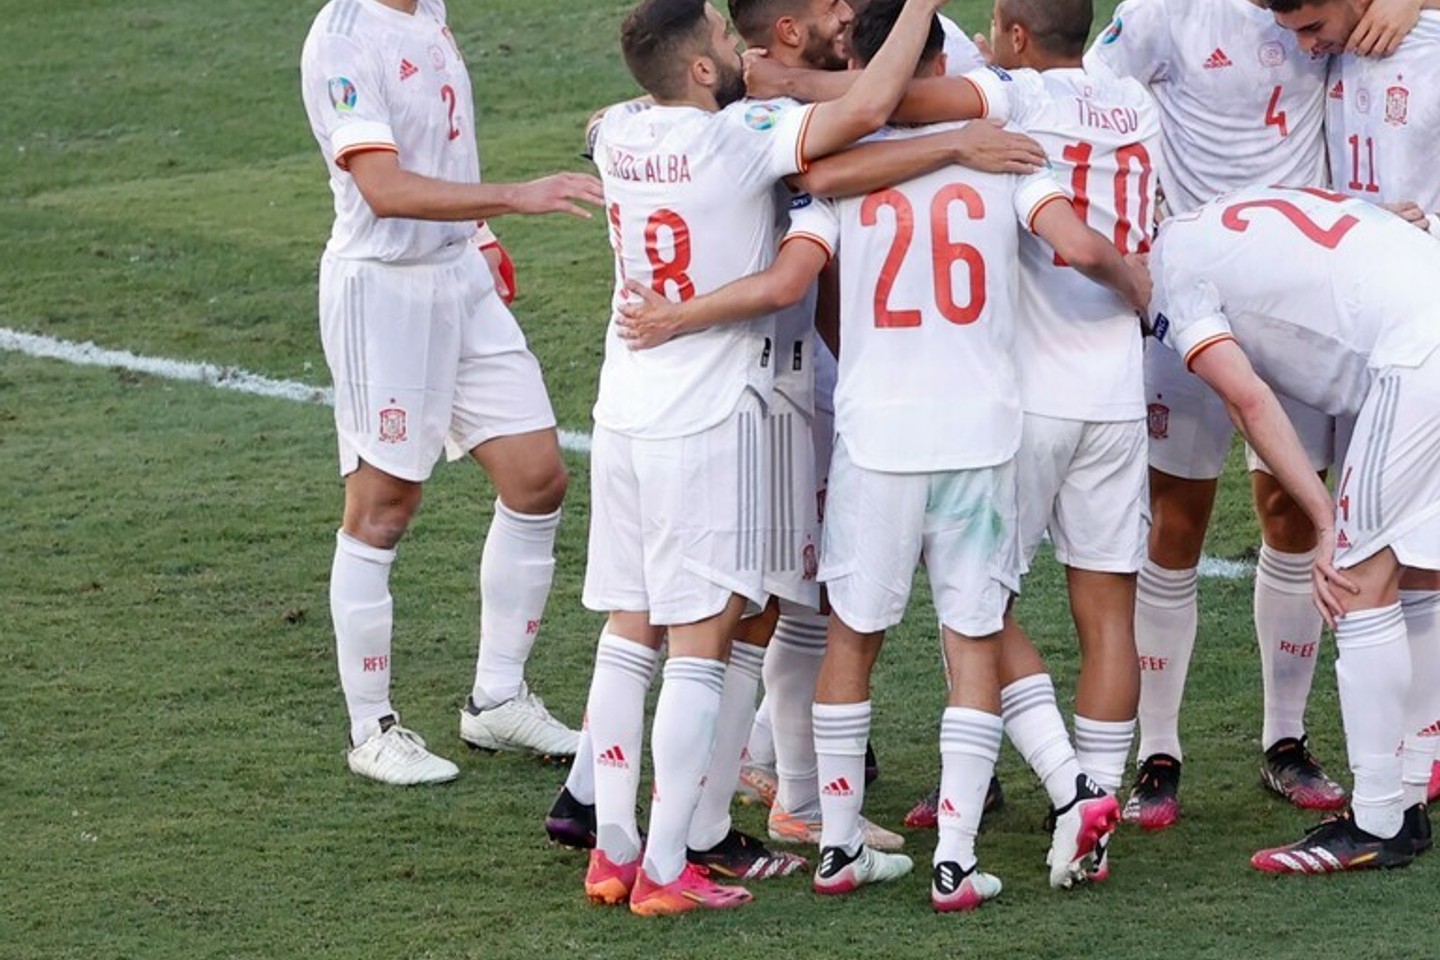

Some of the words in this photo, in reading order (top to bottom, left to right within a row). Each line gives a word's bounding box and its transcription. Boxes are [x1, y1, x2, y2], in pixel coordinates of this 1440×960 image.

[441, 85, 460, 140] 2
[1265, 85, 1287, 137] 4
[645, 153, 691, 183] ALBA
[1348, 133, 1380, 193] 11
[1053, 141, 1153, 267] 10
[860, 183, 987, 328] 26
